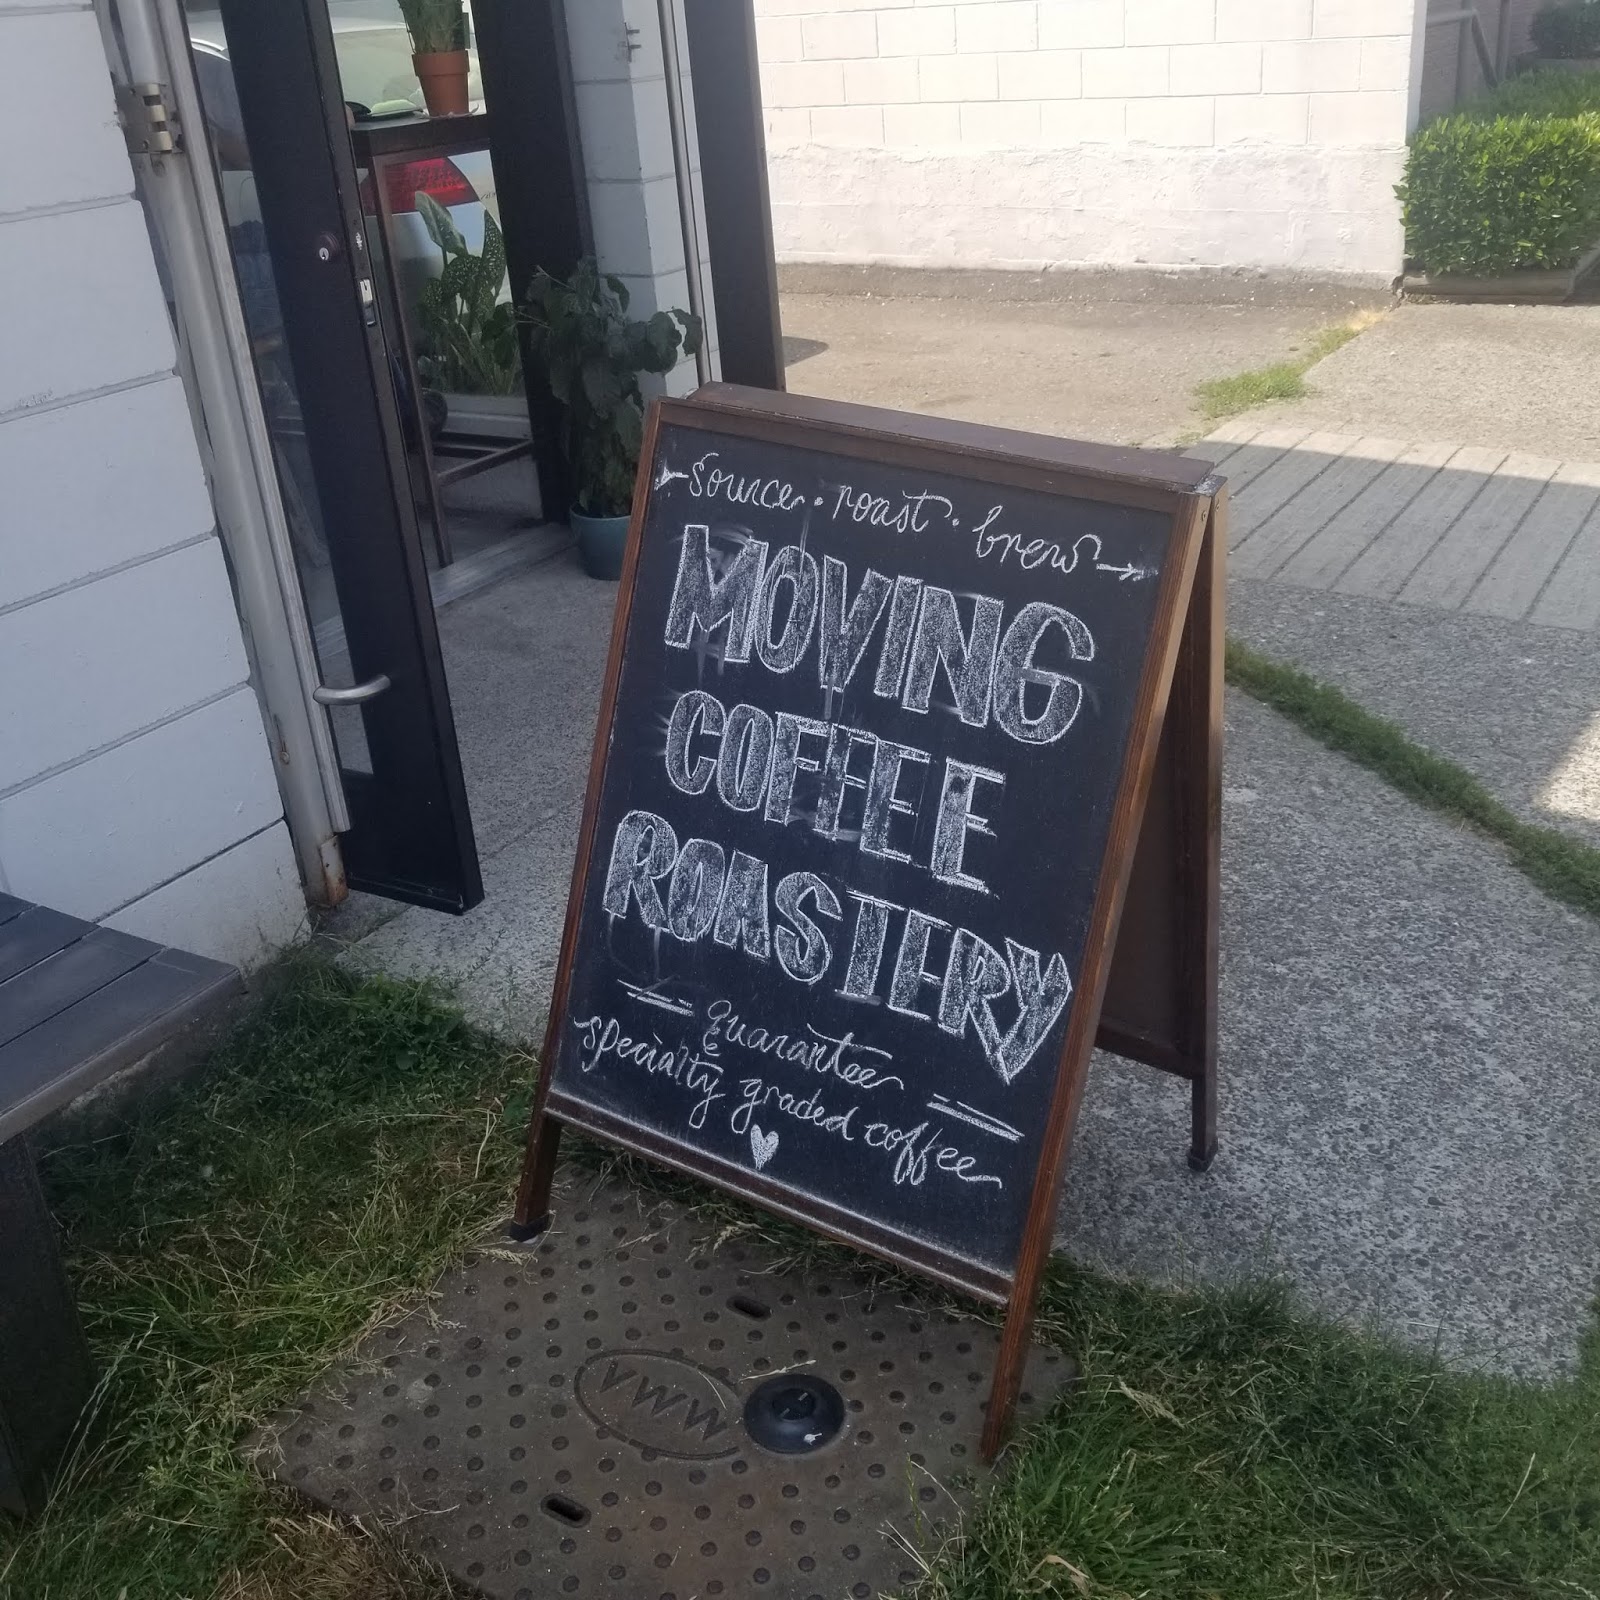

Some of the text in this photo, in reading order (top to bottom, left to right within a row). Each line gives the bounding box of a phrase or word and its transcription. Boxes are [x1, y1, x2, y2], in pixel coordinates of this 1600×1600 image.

[664, 524, 1096, 745] MOVING
[665, 690, 1006, 897] COFFEE
[602, 810, 1074, 1085] ROASTERY
[864, 1121, 1003, 1189] coffee
